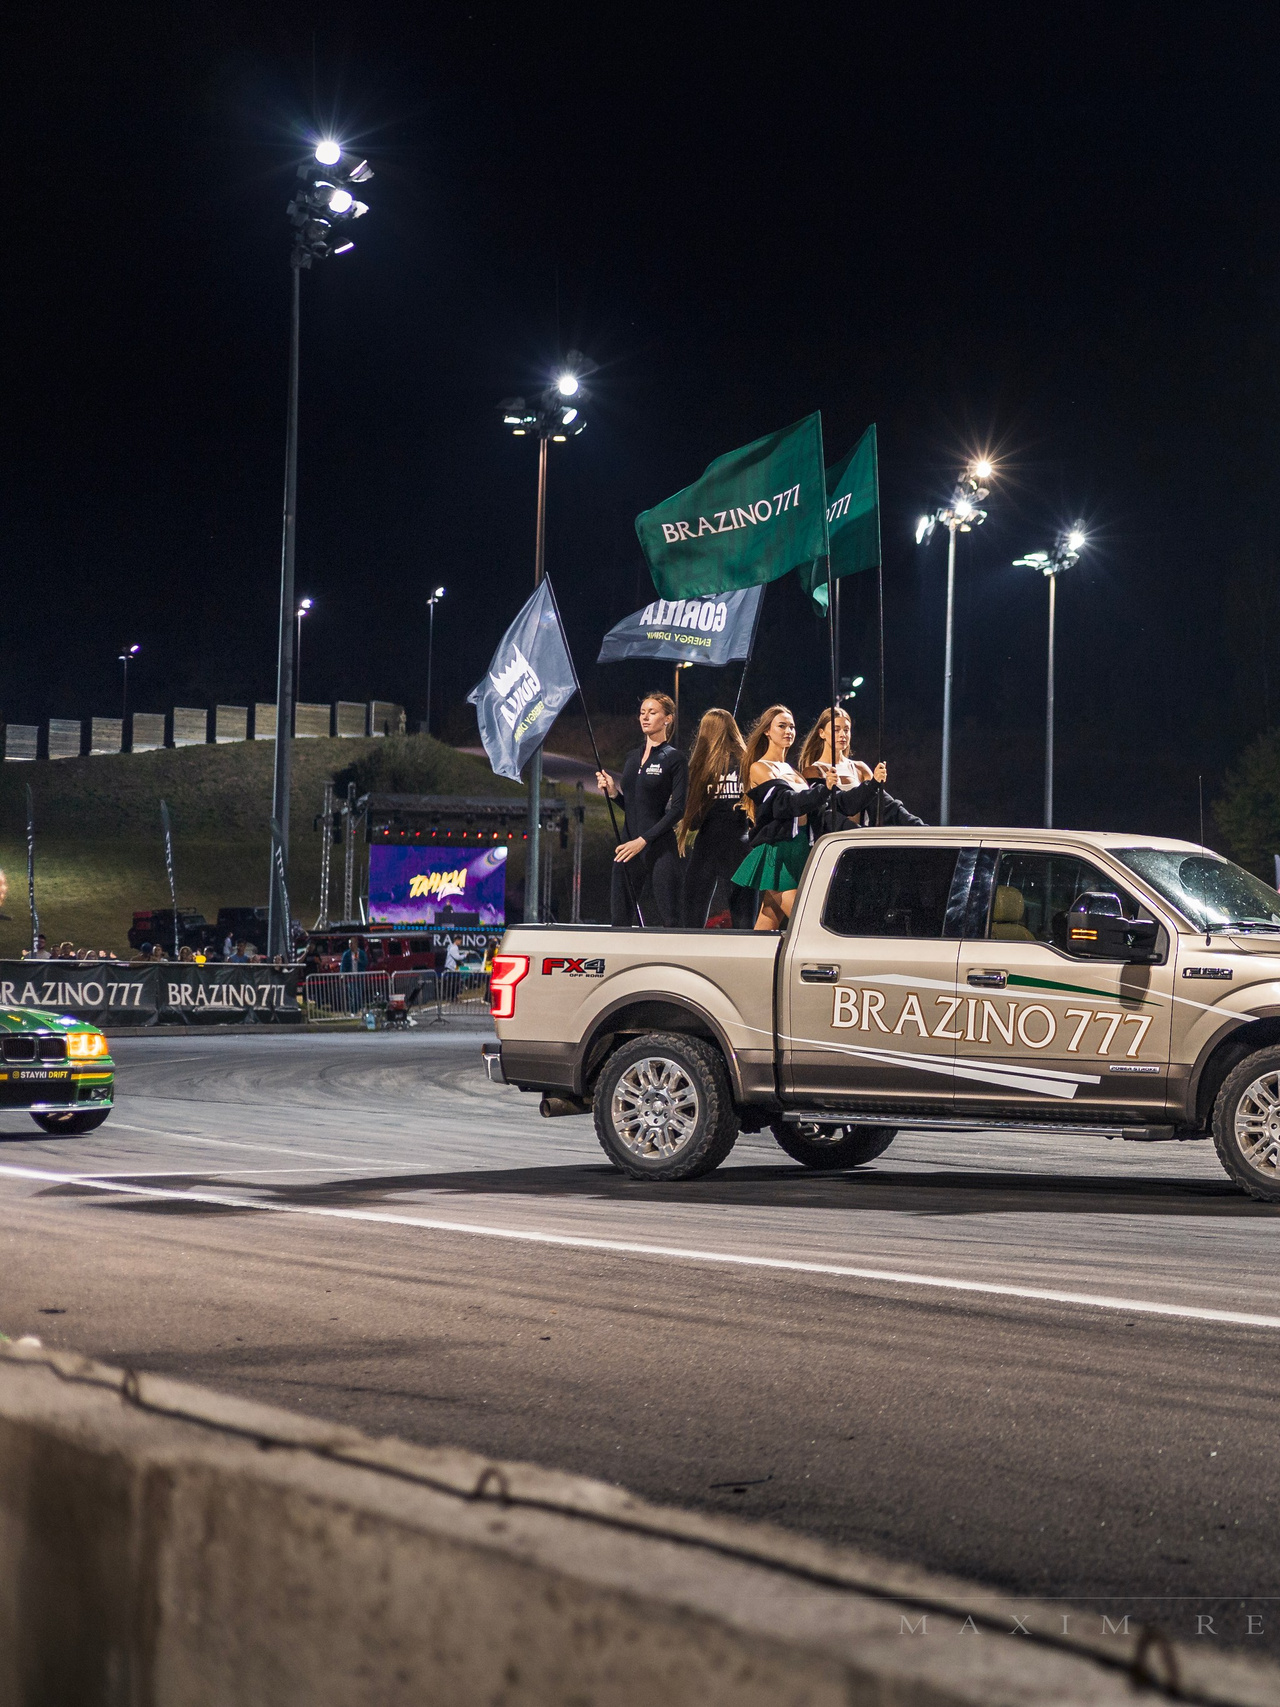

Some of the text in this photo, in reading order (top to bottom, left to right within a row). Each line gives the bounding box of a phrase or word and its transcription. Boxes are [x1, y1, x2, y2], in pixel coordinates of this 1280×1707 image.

[542, 957, 605, 975] FX4
[20, 1071, 68, 1079] STAYKI DRIFT
